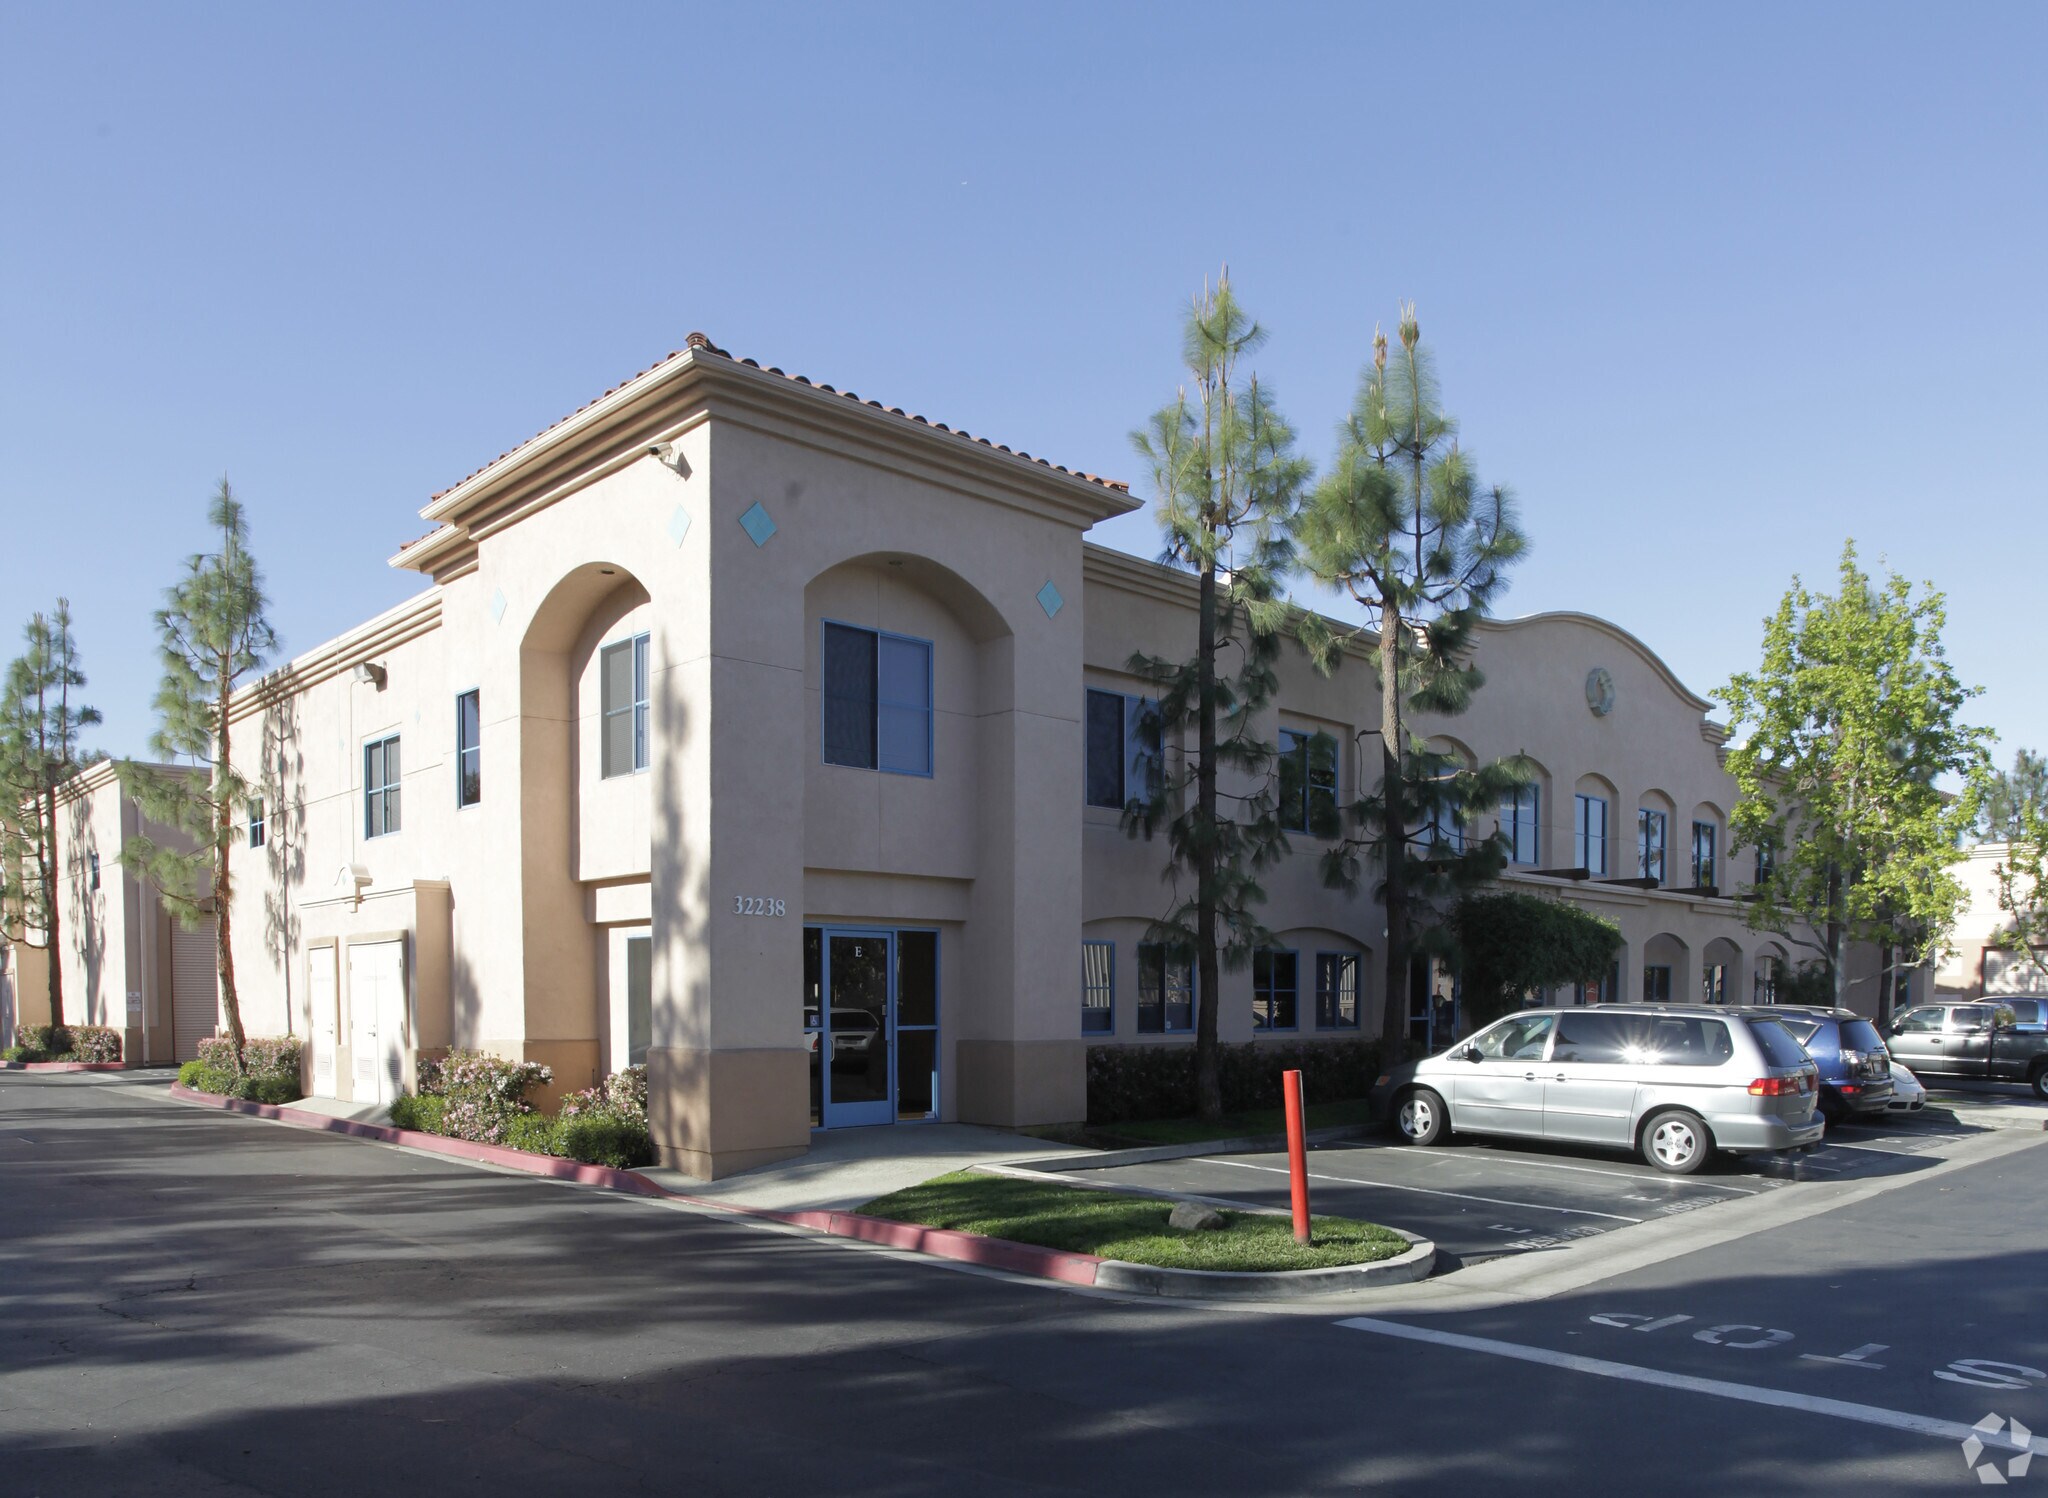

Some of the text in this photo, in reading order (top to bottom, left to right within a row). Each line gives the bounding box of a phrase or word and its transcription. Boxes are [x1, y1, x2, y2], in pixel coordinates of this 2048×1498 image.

[733, 895, 786, 917] 32238
[855, 946, 863, 957] E
[1589, 1313, 2047, 1390] STOP
